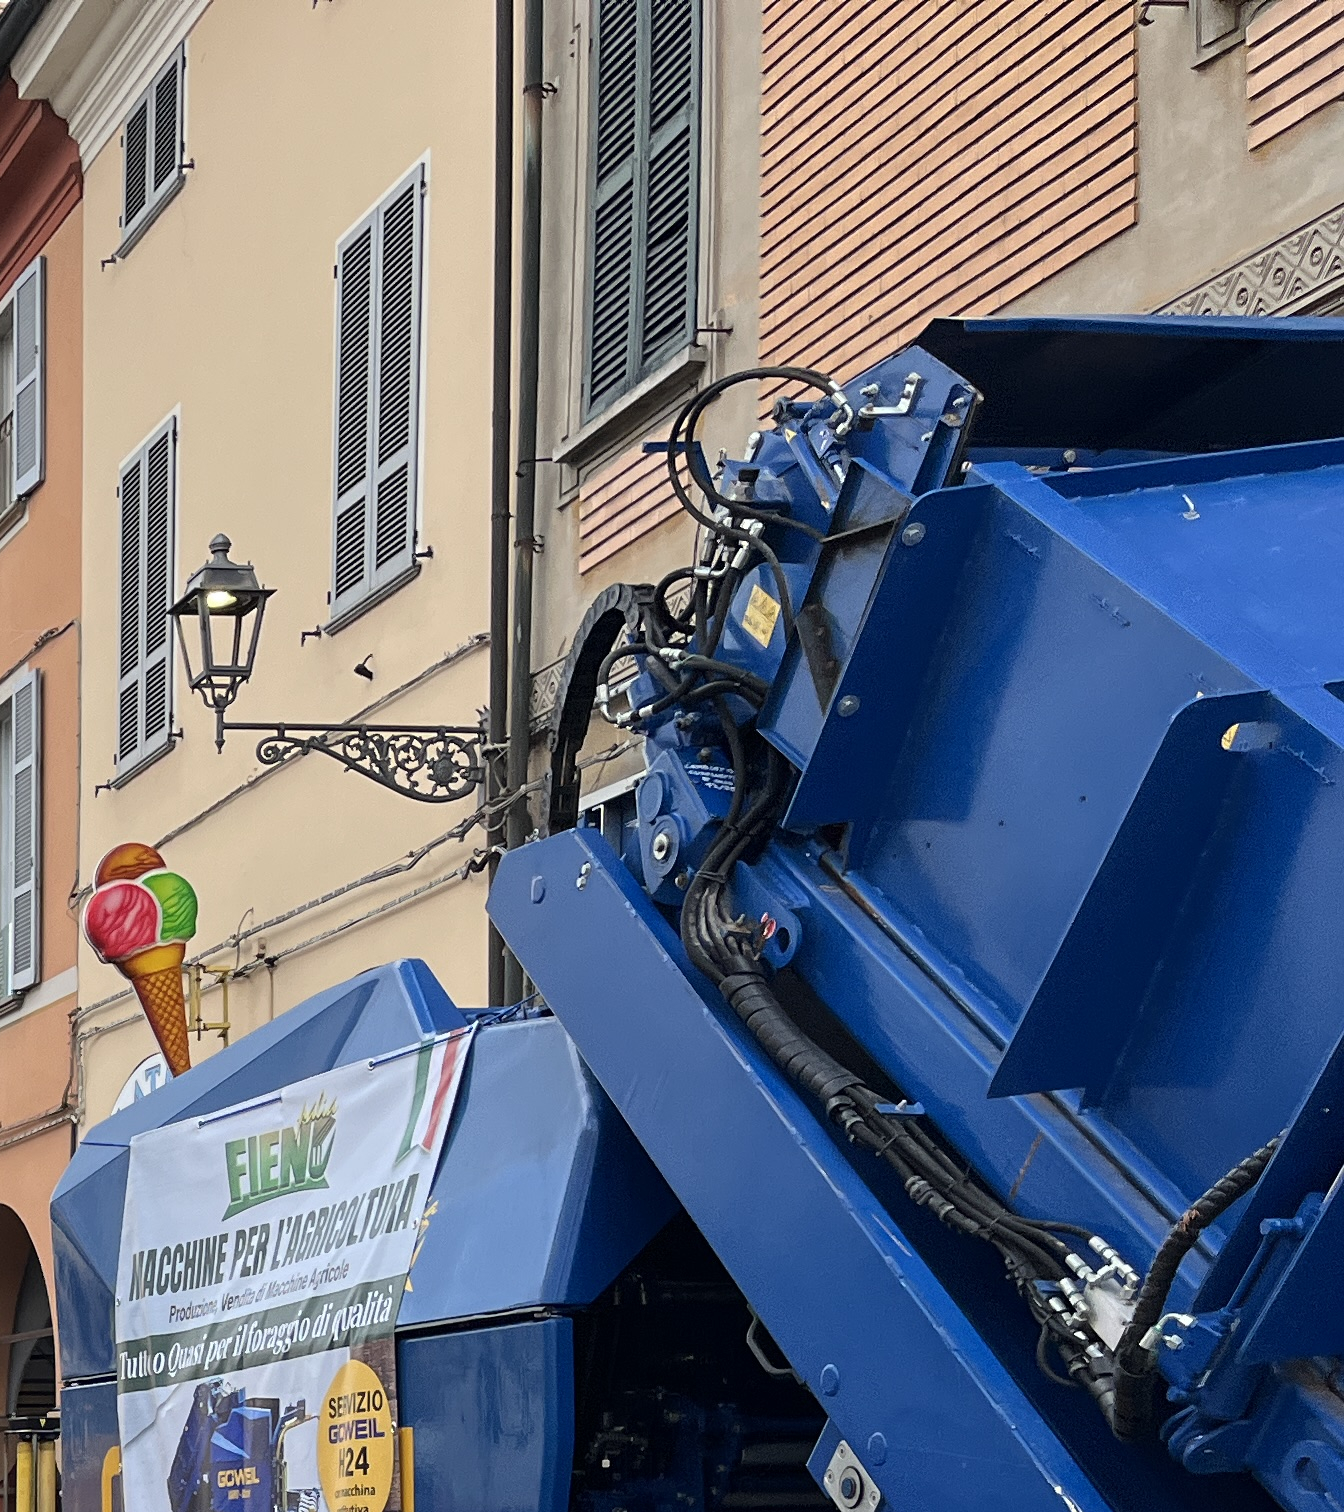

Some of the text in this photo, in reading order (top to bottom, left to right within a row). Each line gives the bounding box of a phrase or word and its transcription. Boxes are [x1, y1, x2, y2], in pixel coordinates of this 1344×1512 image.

[224, 1117, 336, 1202] FIENO
[229, 1222, 270, 1281] PER
[308, 1259, 349, 1290] Agricole
[168, 1333, 206, 1377] Quasi
[204, 1335, 232, 1370] per
[232, 1322, 247, 1357] il
[245, 1310, 310, 1354] foraggio
[312, 1296, 332, 1338] di
[331, 1285, 393, 1341] qualità
[338, 1446, 370, 1478] H24
